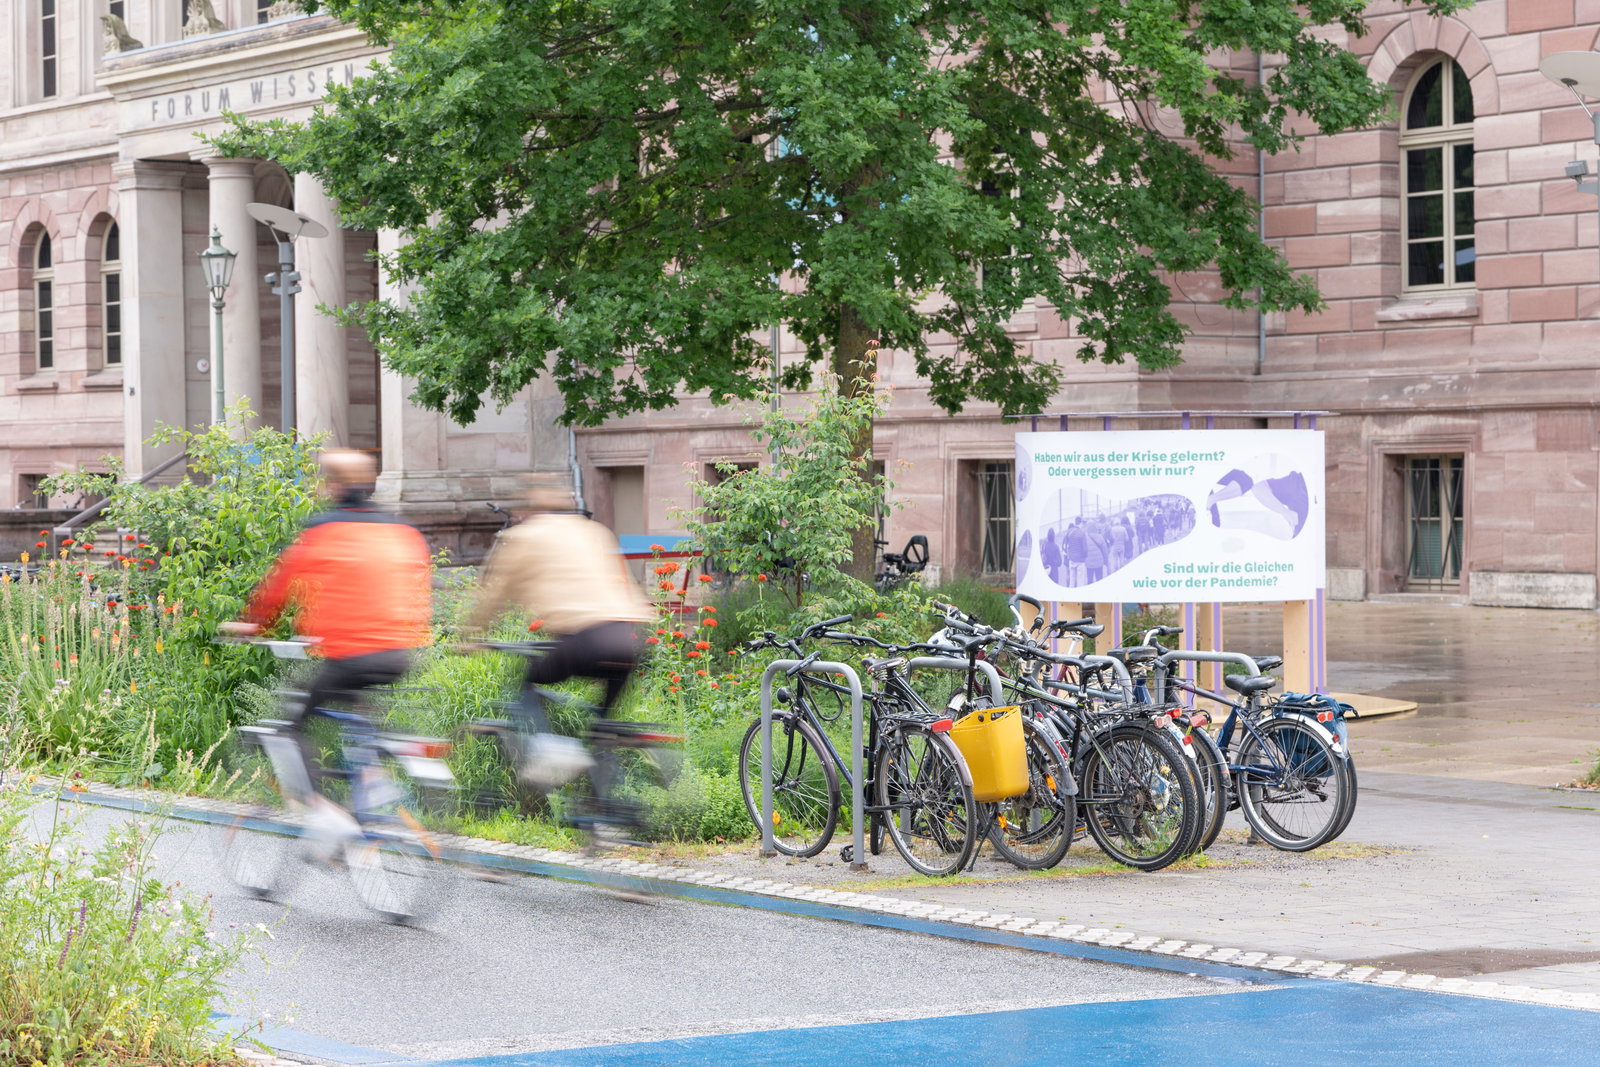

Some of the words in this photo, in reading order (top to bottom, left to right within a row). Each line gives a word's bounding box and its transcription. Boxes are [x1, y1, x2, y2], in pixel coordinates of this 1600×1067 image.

[152, 87, 231, 121] FORUM
[250, 63, 354, 104] WISSEN
[1034, 452, 1062, 463] Haben
[1063, 451, 1081, 462] wir
[1083, 453, 1105, 462] aus
[1107, 451, 1129, 462] der
[1132, 450, 1167, 462] Krise
[1170, 450, 1225, 464] gelernt?
[1048, 466, 1071, 477] Oder
[1073, 467, 1137, 479] vergessen
[1139, 464, 1162, 476] wir
[1165, 465, 1195, 476] nur?
[1163, 562, 1194, 574] Sind
[1197, 562, 1219, 573] wir
[1221, 561, 1242, 573] die
[1244, 560, 1294, 573] Gleichen
[1132, 576, 1157, 588] wie
[1160, 578, 1182, 588] vor
[1185, 577, 1207, 588] der
[1210, 575, 1278, 588] Pandemie?
